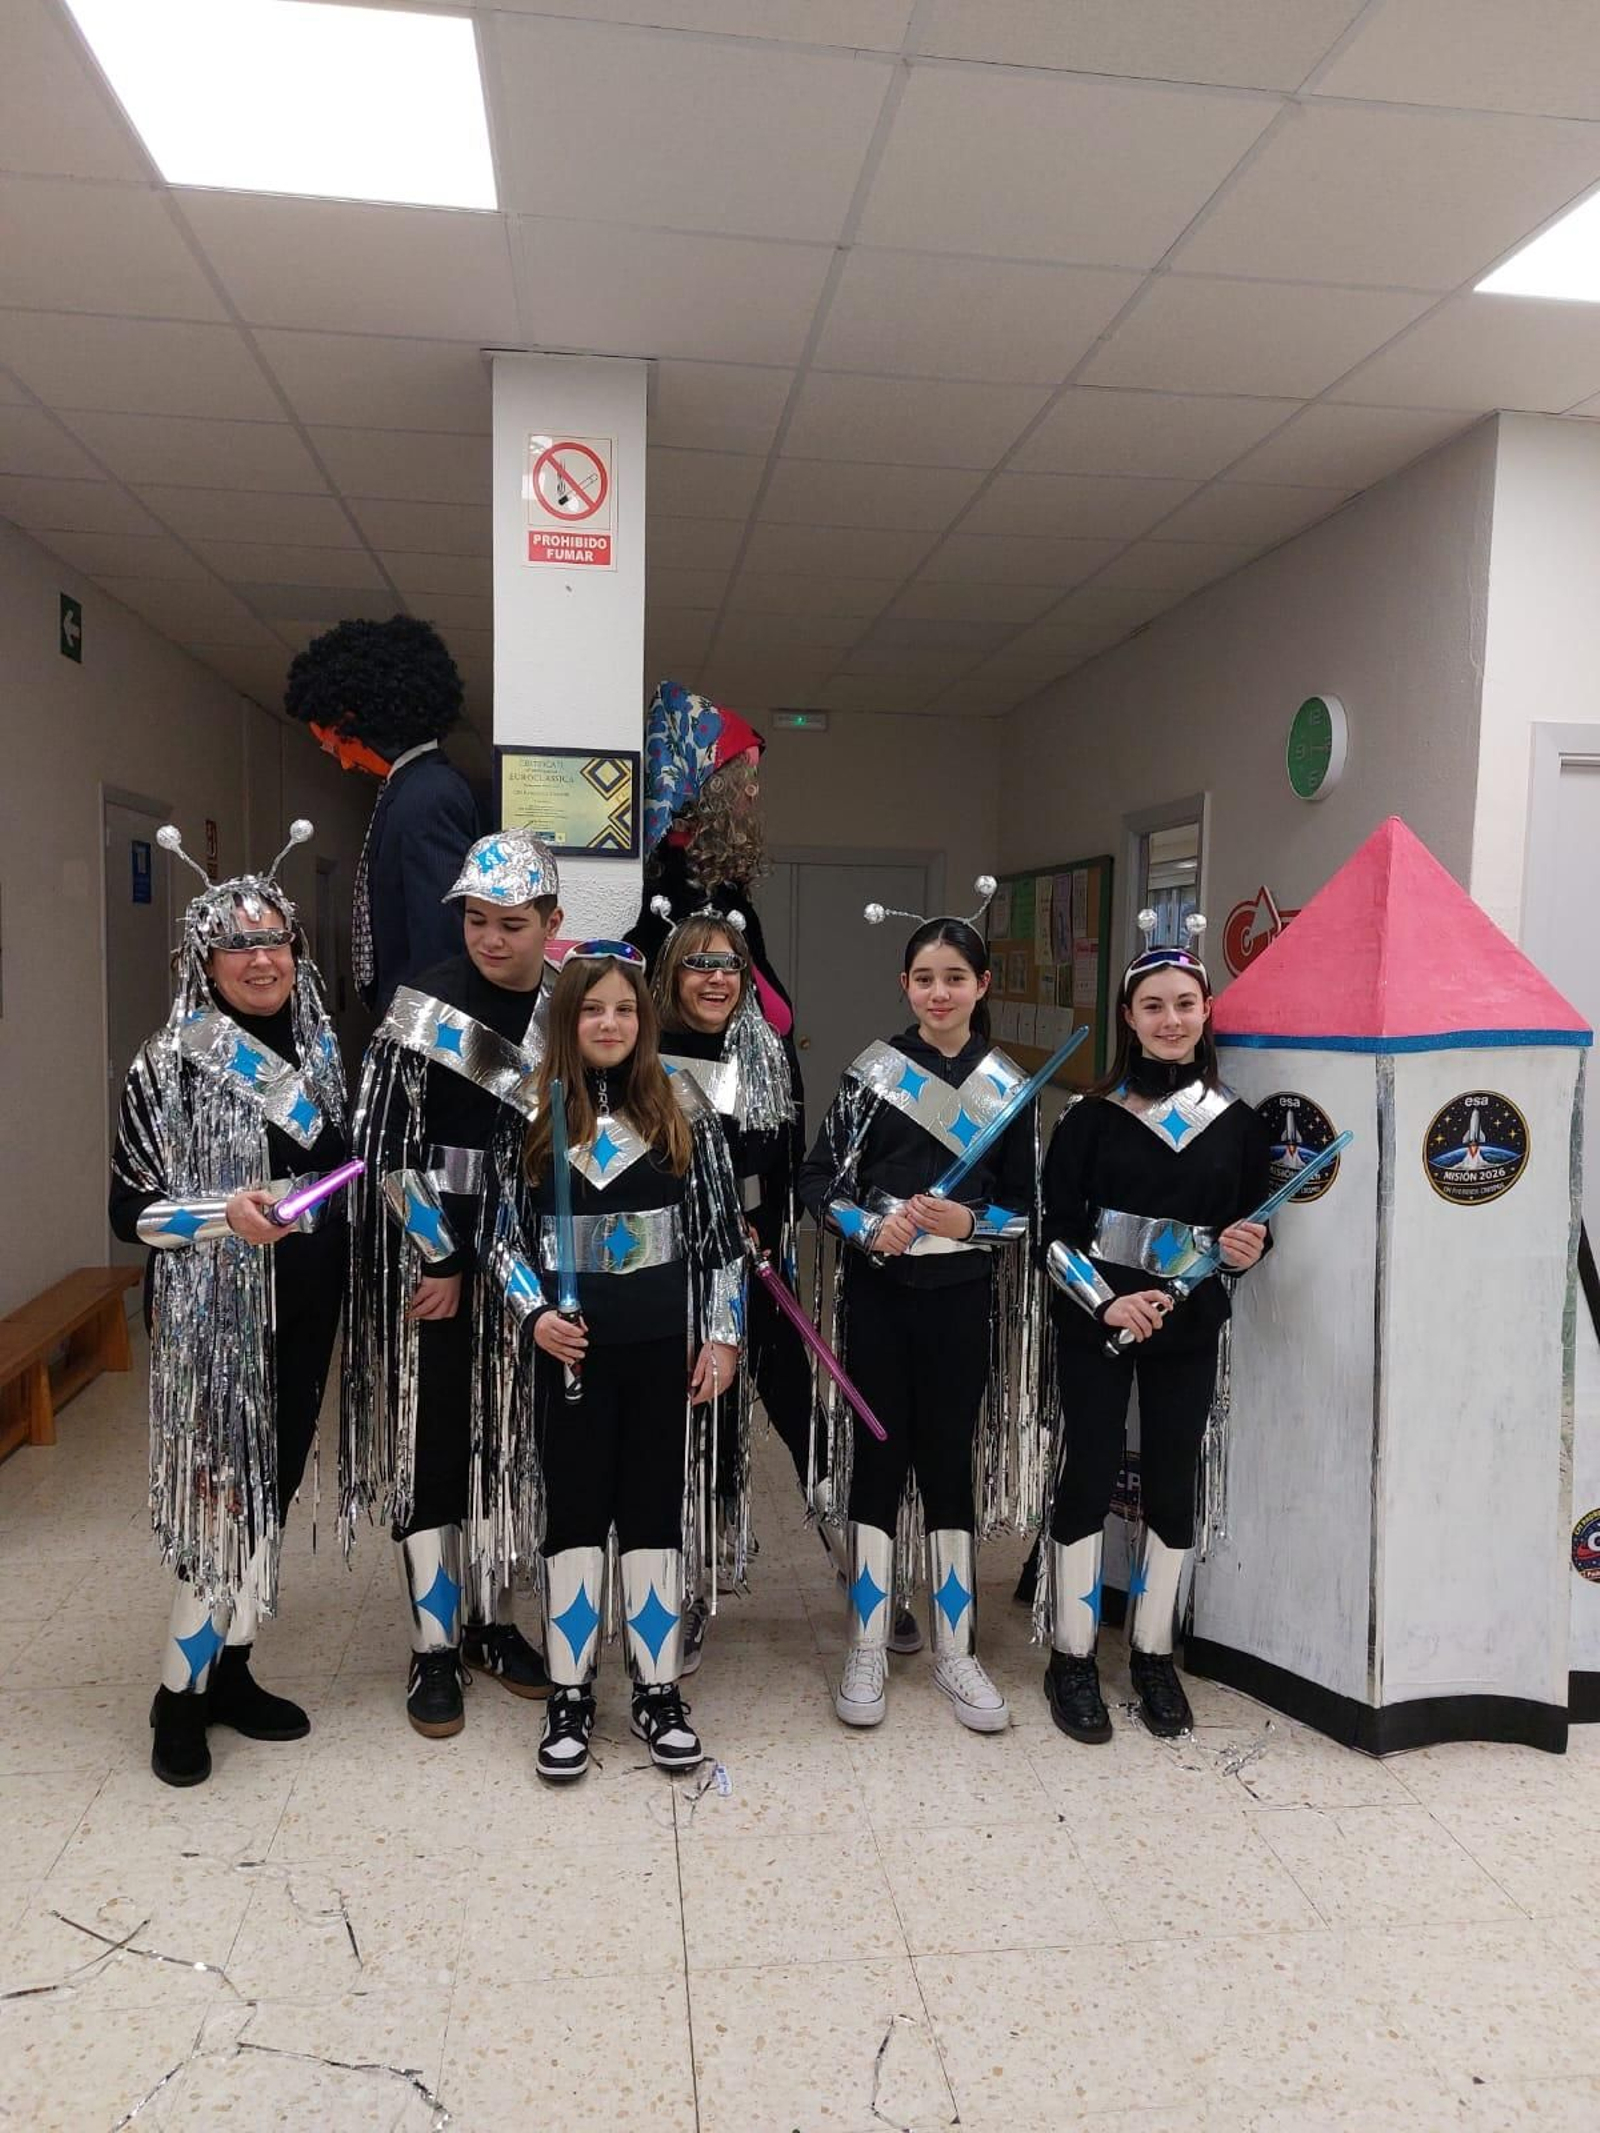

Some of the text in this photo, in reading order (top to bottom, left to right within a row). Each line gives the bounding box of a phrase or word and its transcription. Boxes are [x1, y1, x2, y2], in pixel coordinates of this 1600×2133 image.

[533, 534, 607, 549] PROHIBIDO
[547, 549, 594, 562] FUMAR
[1280, 1097, 1300, 1108] esa
[1464, 1096, 1489, 1107] esa
[1443, 1167, 1506, 1182] MISIÓN 2026
